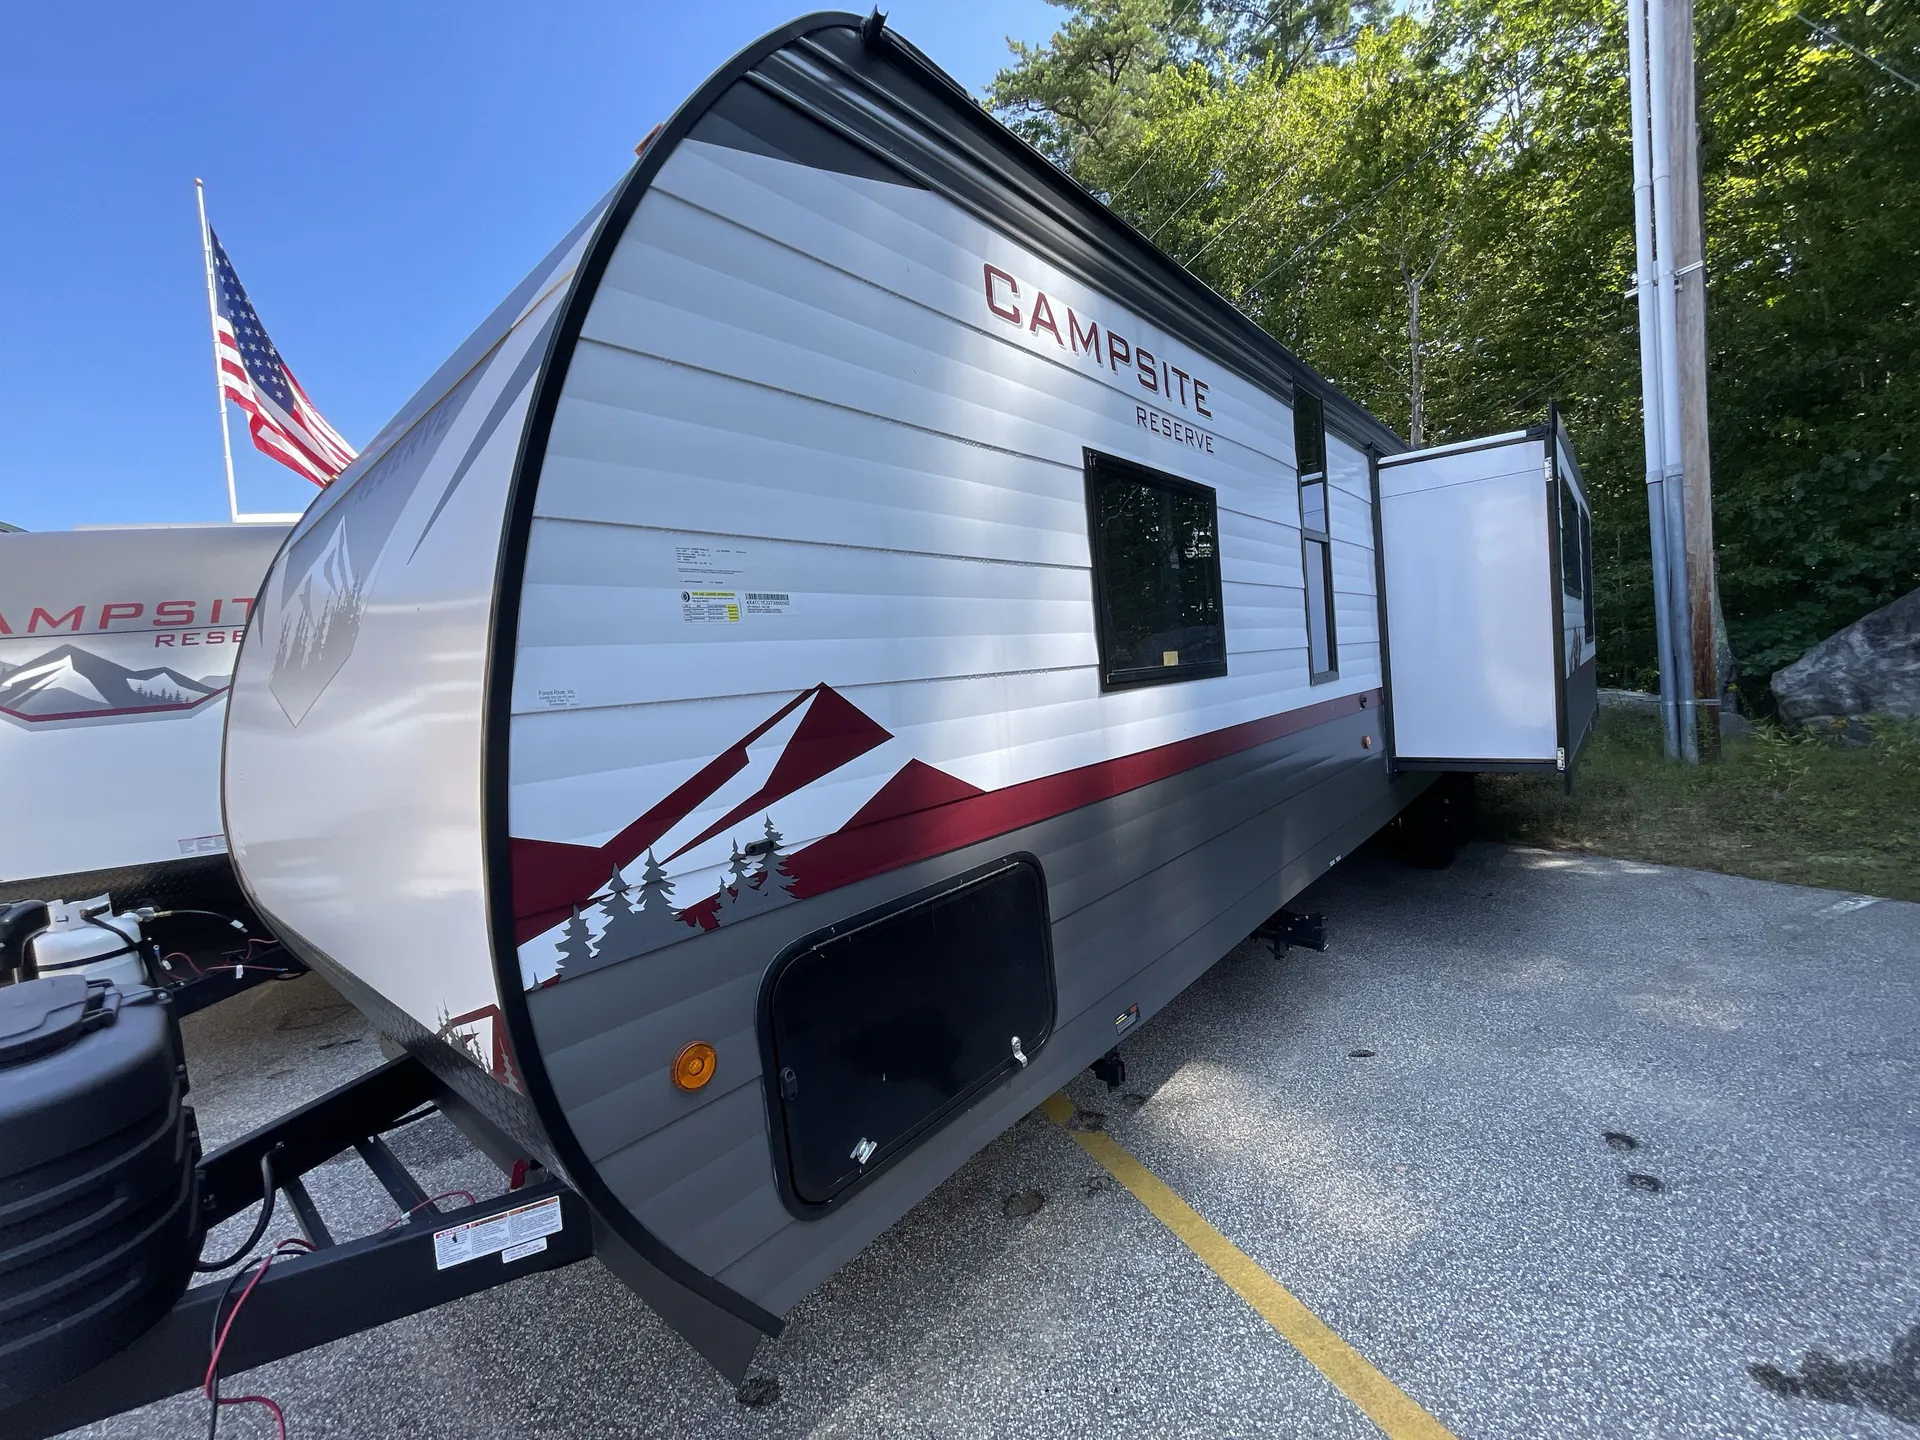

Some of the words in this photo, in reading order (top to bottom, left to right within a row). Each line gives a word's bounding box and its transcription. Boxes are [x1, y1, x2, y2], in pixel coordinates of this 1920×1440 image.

[983, 262, 1213, 419] CAMPSITE
[1136, 405, 1214, 454] RESERVE
[0, 597, 255, 634] MPSIT
[155, 630, 244, 648] RESE
